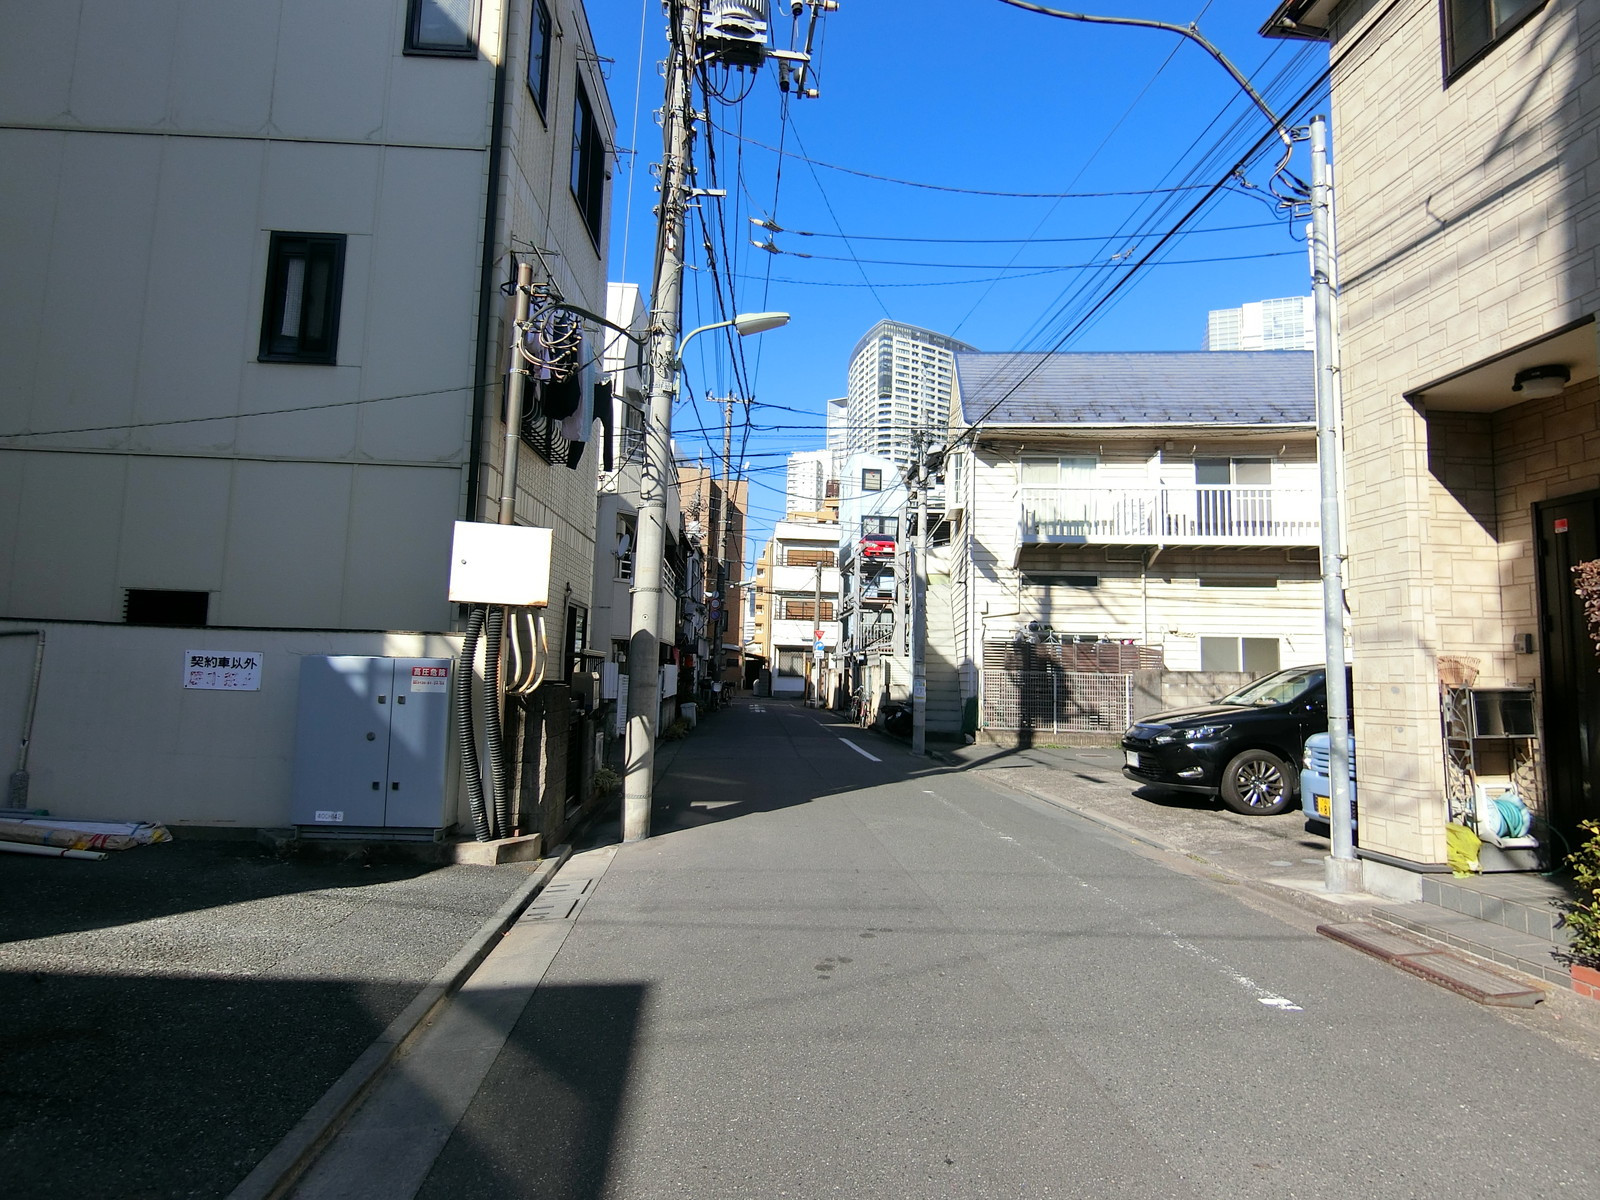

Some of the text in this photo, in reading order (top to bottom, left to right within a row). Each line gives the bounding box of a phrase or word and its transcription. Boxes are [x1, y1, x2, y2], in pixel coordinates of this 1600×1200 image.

[190, 655, 258, 670] 契約車以外
[414, 667, 446, 677] 高圧危険
